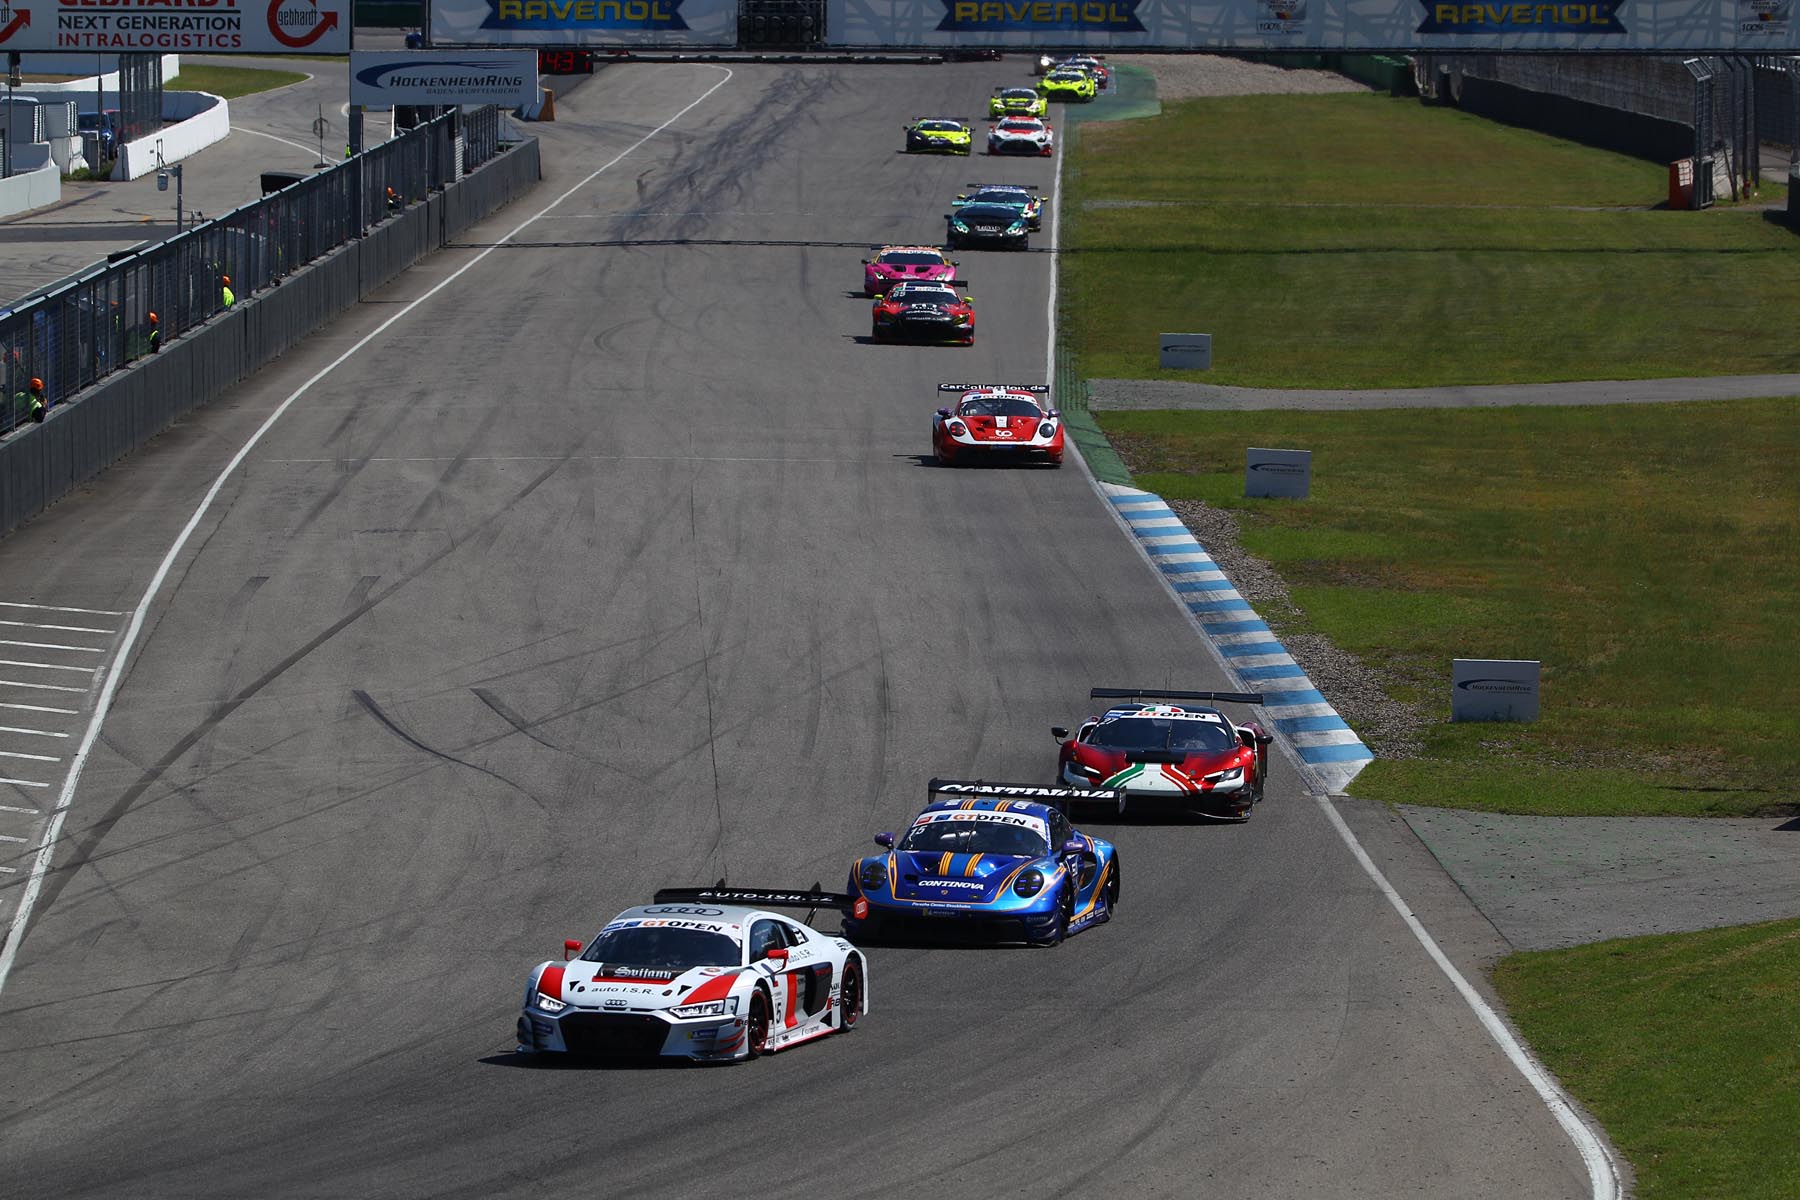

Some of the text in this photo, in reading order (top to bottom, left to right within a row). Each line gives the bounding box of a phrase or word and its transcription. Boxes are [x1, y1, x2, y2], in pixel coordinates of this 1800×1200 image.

[58, 15, 241, 30] NEXT GENERATION
[58, 33, 241, 47] INTRALOGISTICS
[918, 880, 983, 890] CONTINOVA
